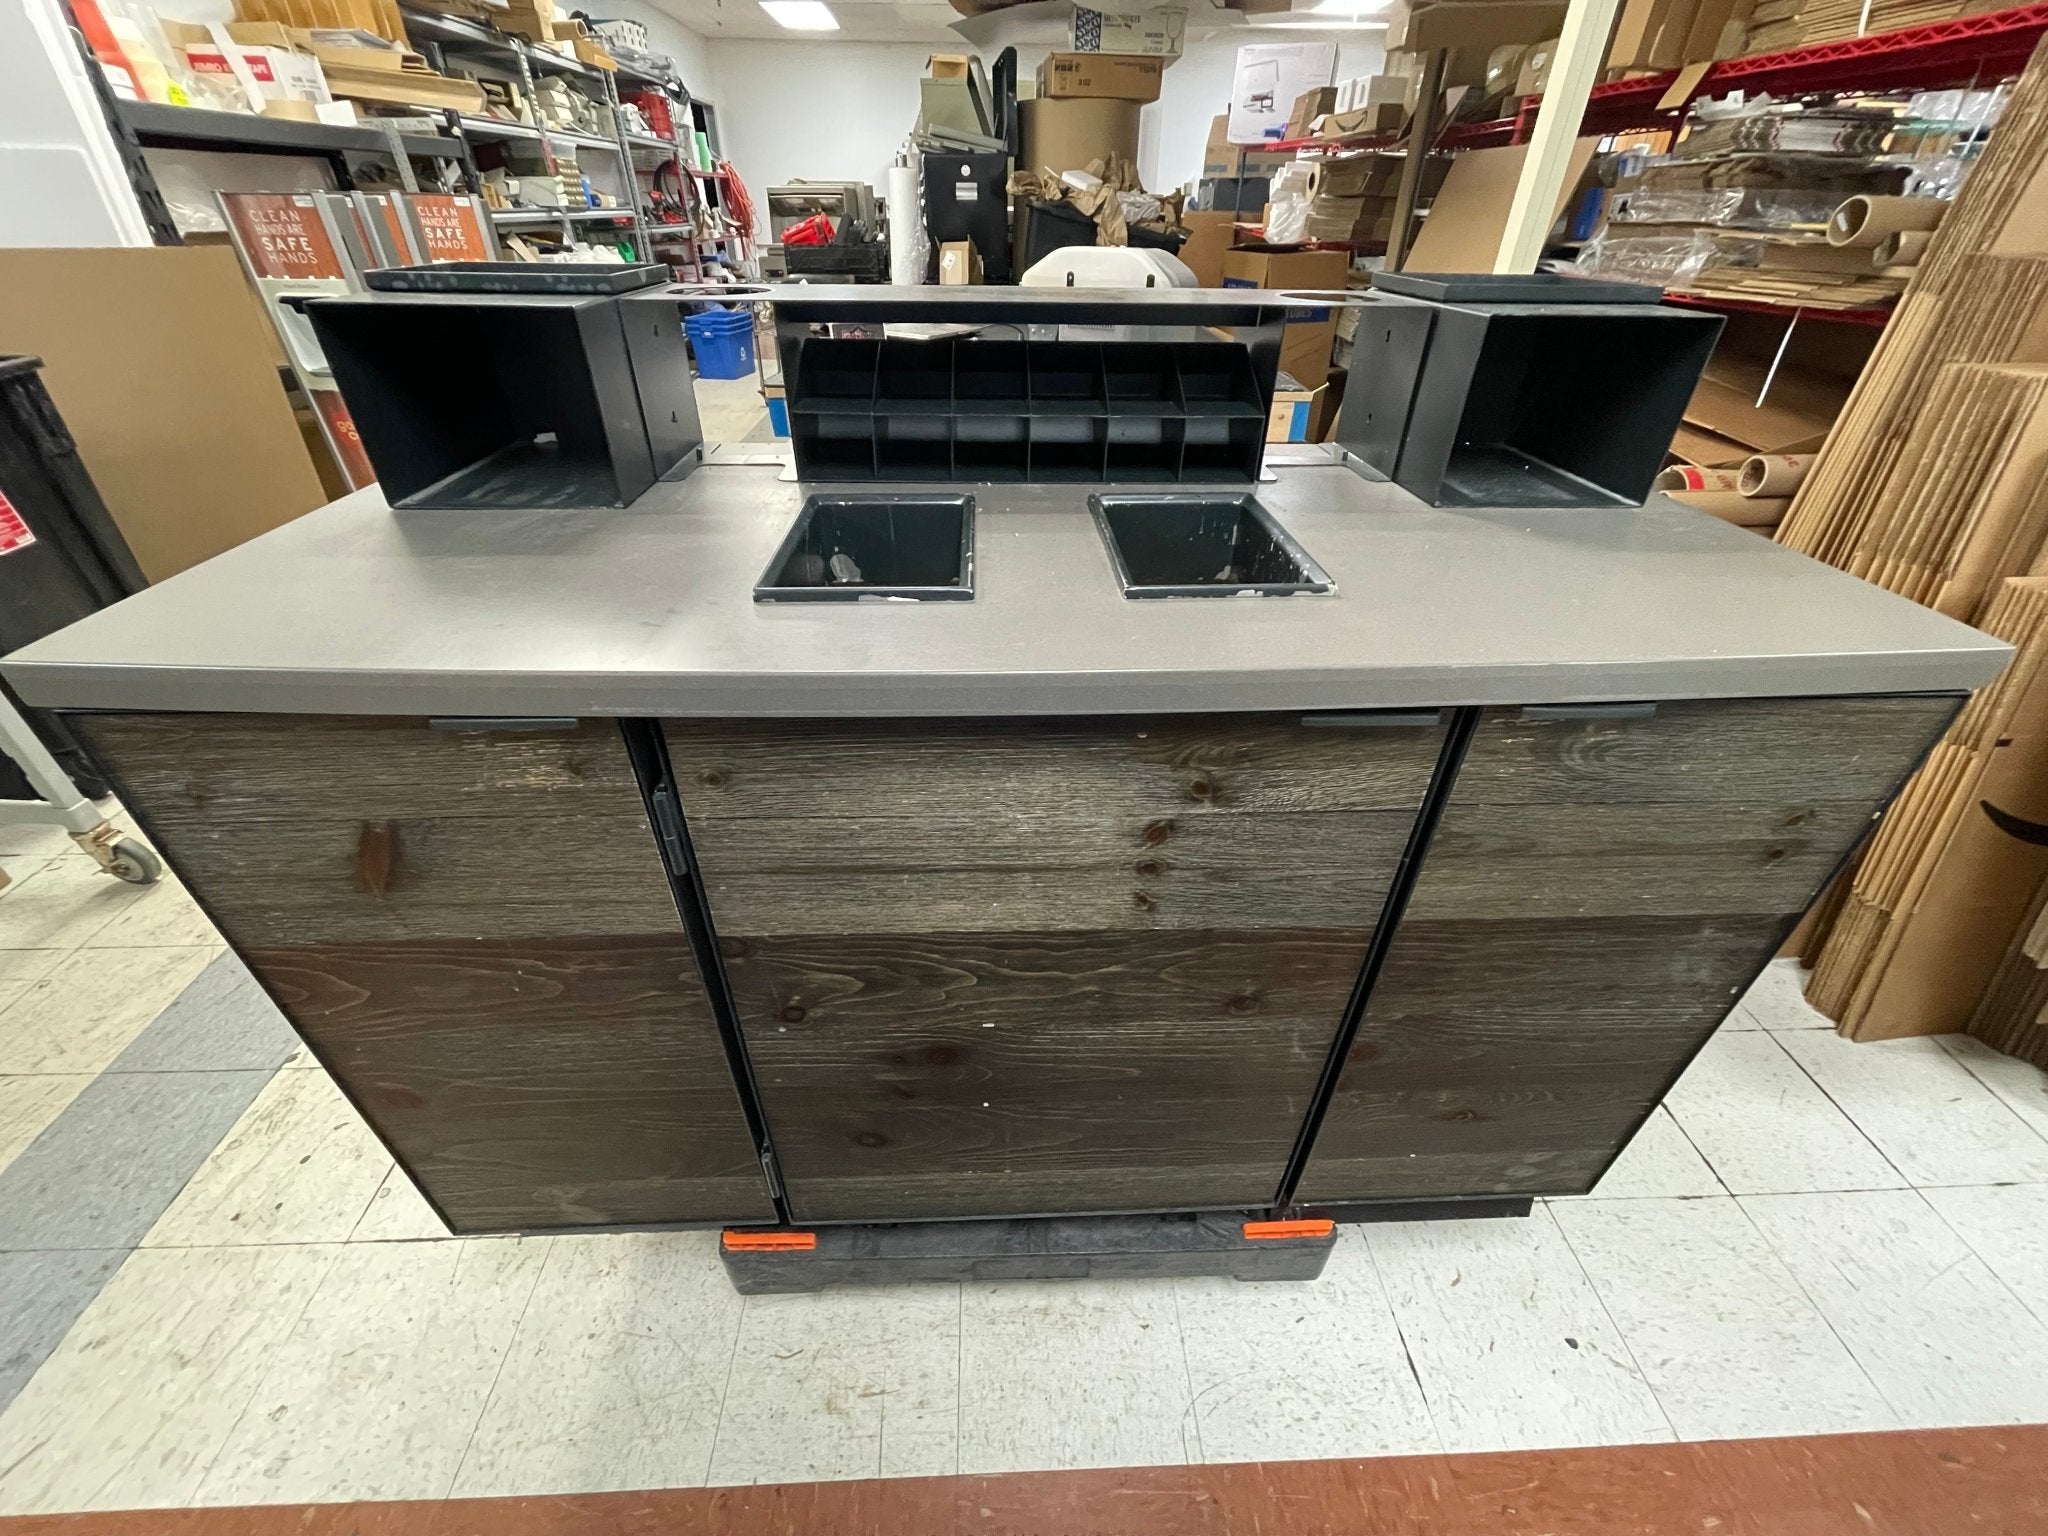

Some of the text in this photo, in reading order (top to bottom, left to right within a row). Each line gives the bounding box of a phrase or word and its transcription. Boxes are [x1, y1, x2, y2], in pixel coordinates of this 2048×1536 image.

[249, 209, 301, 223] CLEAN
[417, 206, 458, 217] CLEAN
[420, 217, 462, 228] HANDS ARE
[254, 224, 307, 236] HANDS ARE
[425, 227, 466, 240] SAFE
[261, 237, 313, 251] SAFE
[428, 239, 468, 250] HANDS
[267, 252, 318, 264] HANDS
